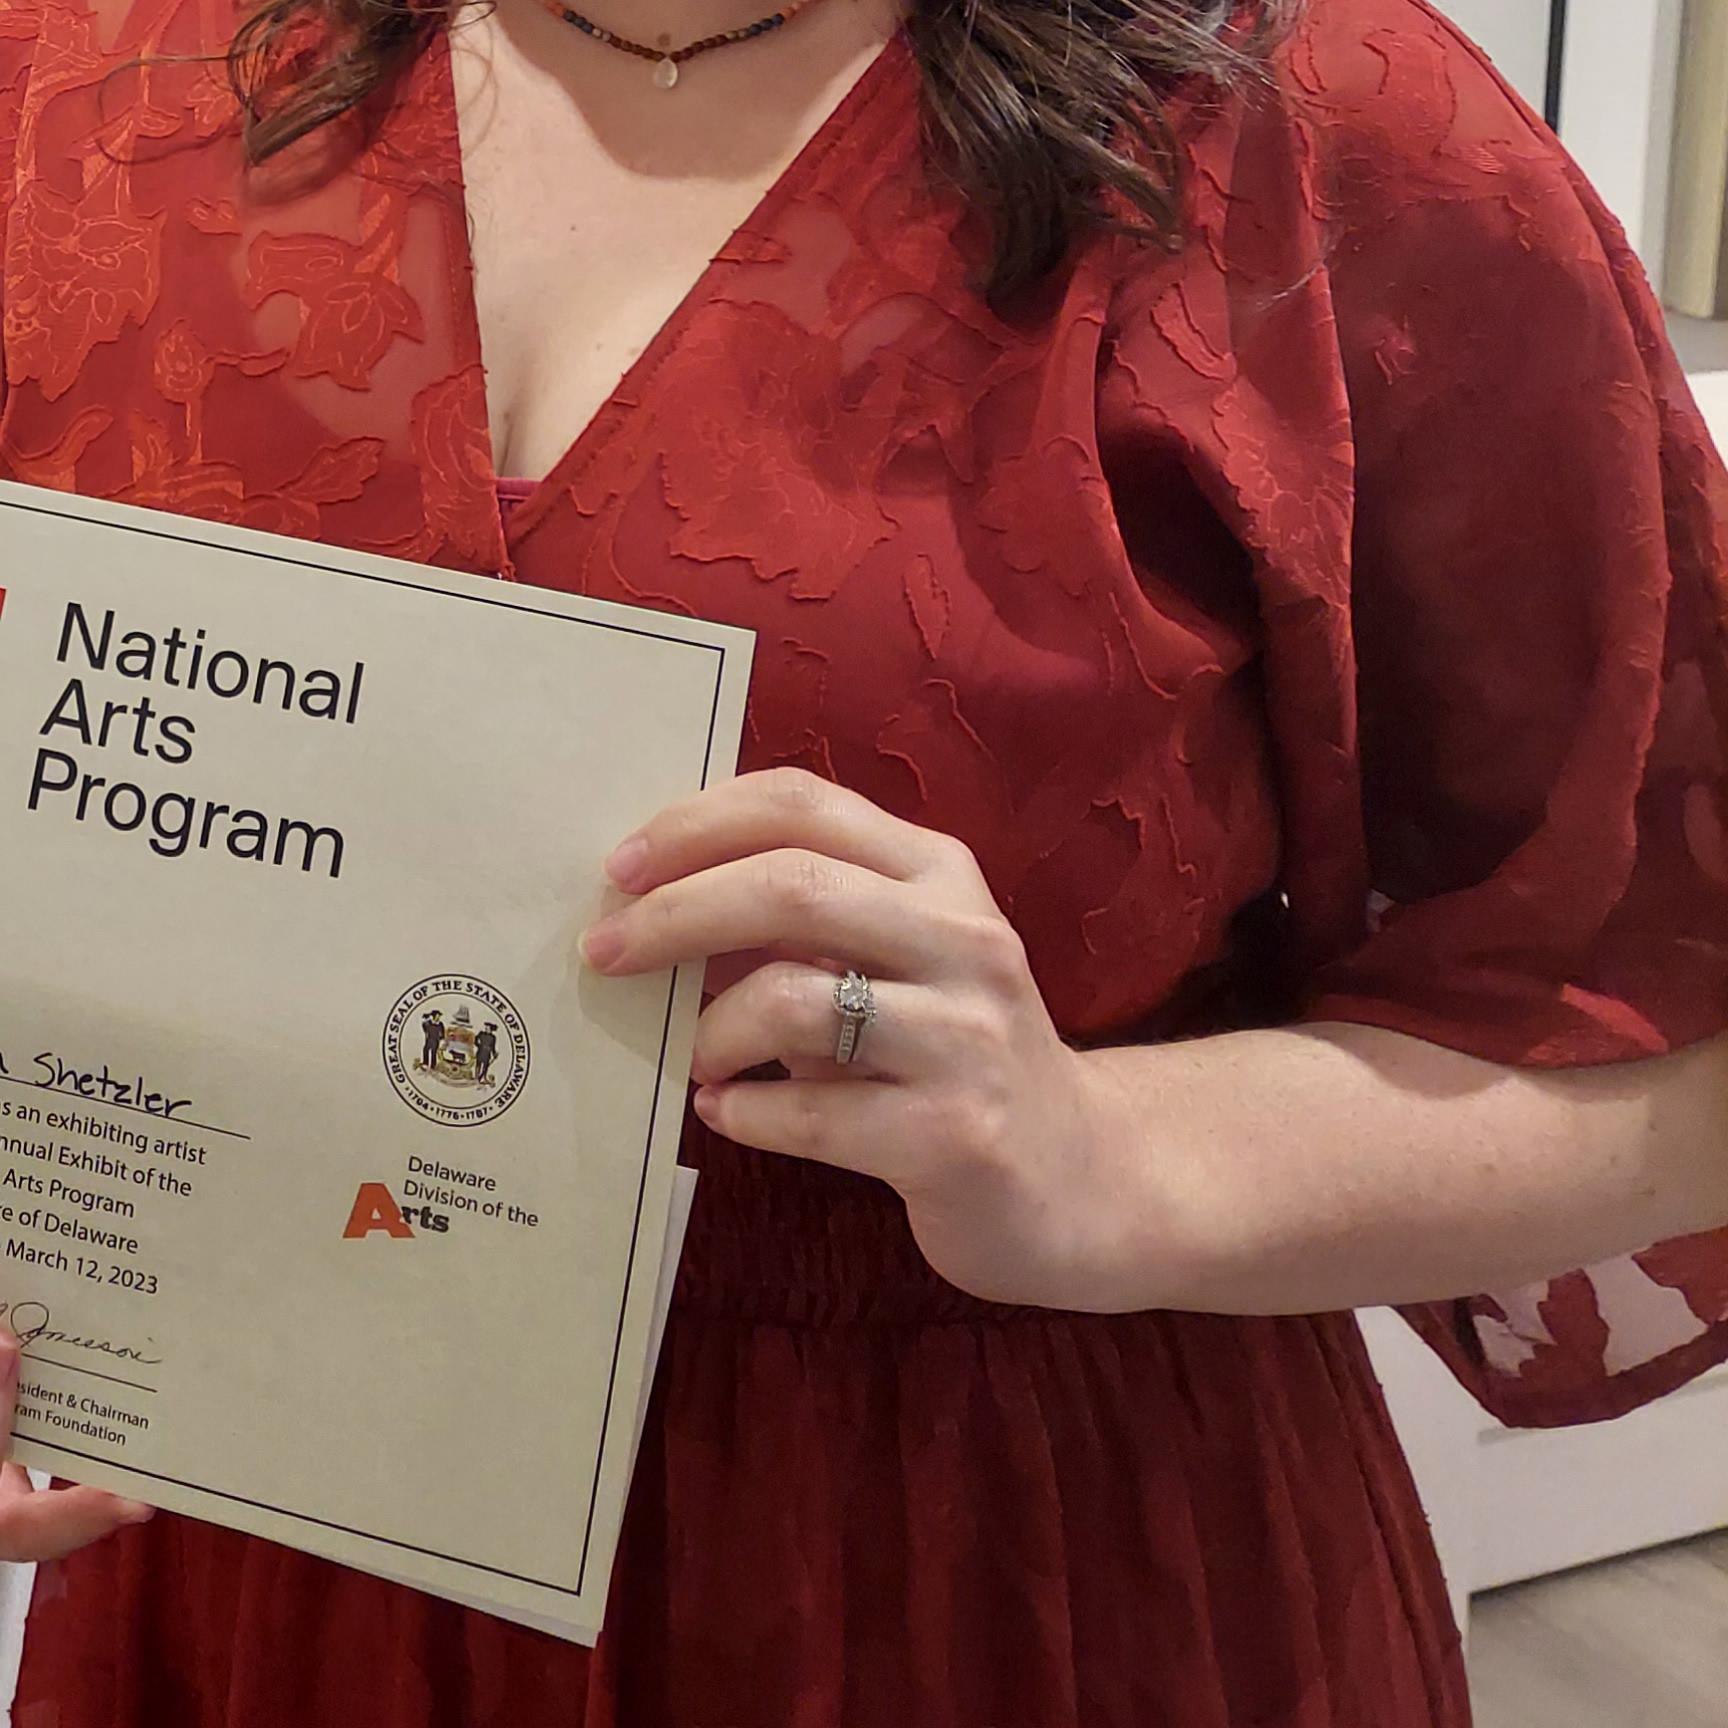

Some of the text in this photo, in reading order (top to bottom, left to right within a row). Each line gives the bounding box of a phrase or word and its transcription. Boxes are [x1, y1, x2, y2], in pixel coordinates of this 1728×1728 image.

[56, 601, 365, 724] National
[39, 678, 196, 764] Arts
[27, 748, 345, 878] Program
[388, 980, 526, 1108] GREAT SEAL OF THE STATE OF DELAWARE
[33, 1052, 192, 1118] Shetzler
[16, 1102, 40, 1124] an
[46, 1110, 149, 1153] exhibiting
[153, 1136, 207, 1165] artist
[3, 1168, 43, 1195] Arts
[49, 1180, 135, 1218] Program
[58, 1147, 129, 1182] Exhibit
[132, 1165, 156, 1187] of
[158, 1173, 192, 1197] the
[408, 1155, 496, 1191] Delaware
[18, 1206, 42, 1230] of
[44, 1213, 139, 1254] Delaware
[342, 1183, 450, 1239] Arts
[403, 1179, 538, 1226] Division of the
[6, 1238, 68, 1271] March
[76, 1257, 103, 1284] 12,
[108, 1265, 159, 1295] 2023
[45, 1412, 127, 1446] Foundation
[66, 1394, 78, 1409] &
[80, 1398, 150, 1430] Chairman
